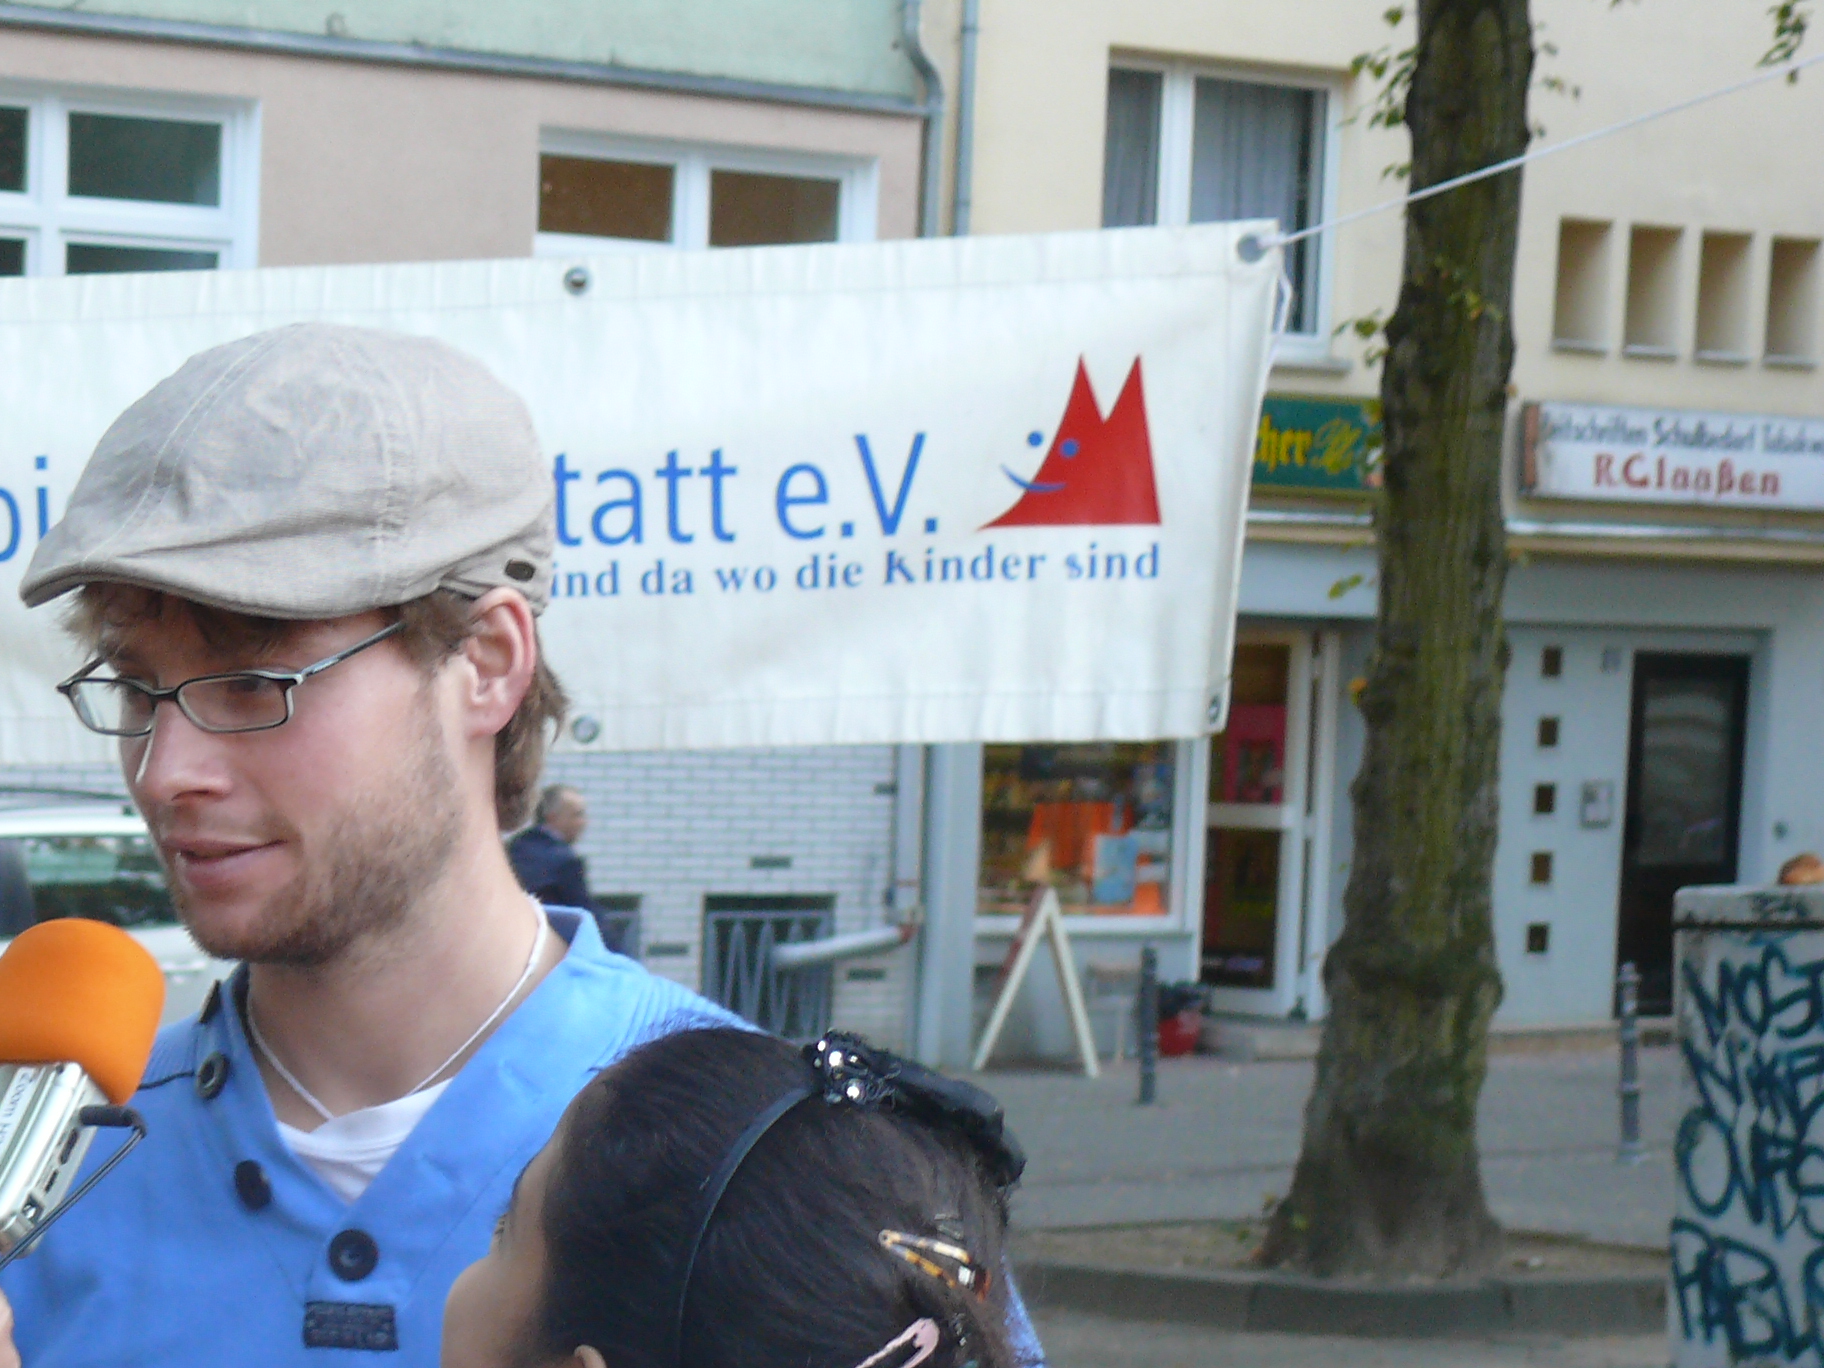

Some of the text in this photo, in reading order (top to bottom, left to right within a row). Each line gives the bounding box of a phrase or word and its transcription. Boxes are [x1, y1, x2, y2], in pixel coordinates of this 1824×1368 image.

[553, 432, 939, 547] tatt e.V.
[640, 559, 695, 597] da
[715, 563, 776, 592] wo
[795, 553, 864, 589] die
[883, 545, 1046, 585] Kinder
[1064, 542, 1160, 581] sind
